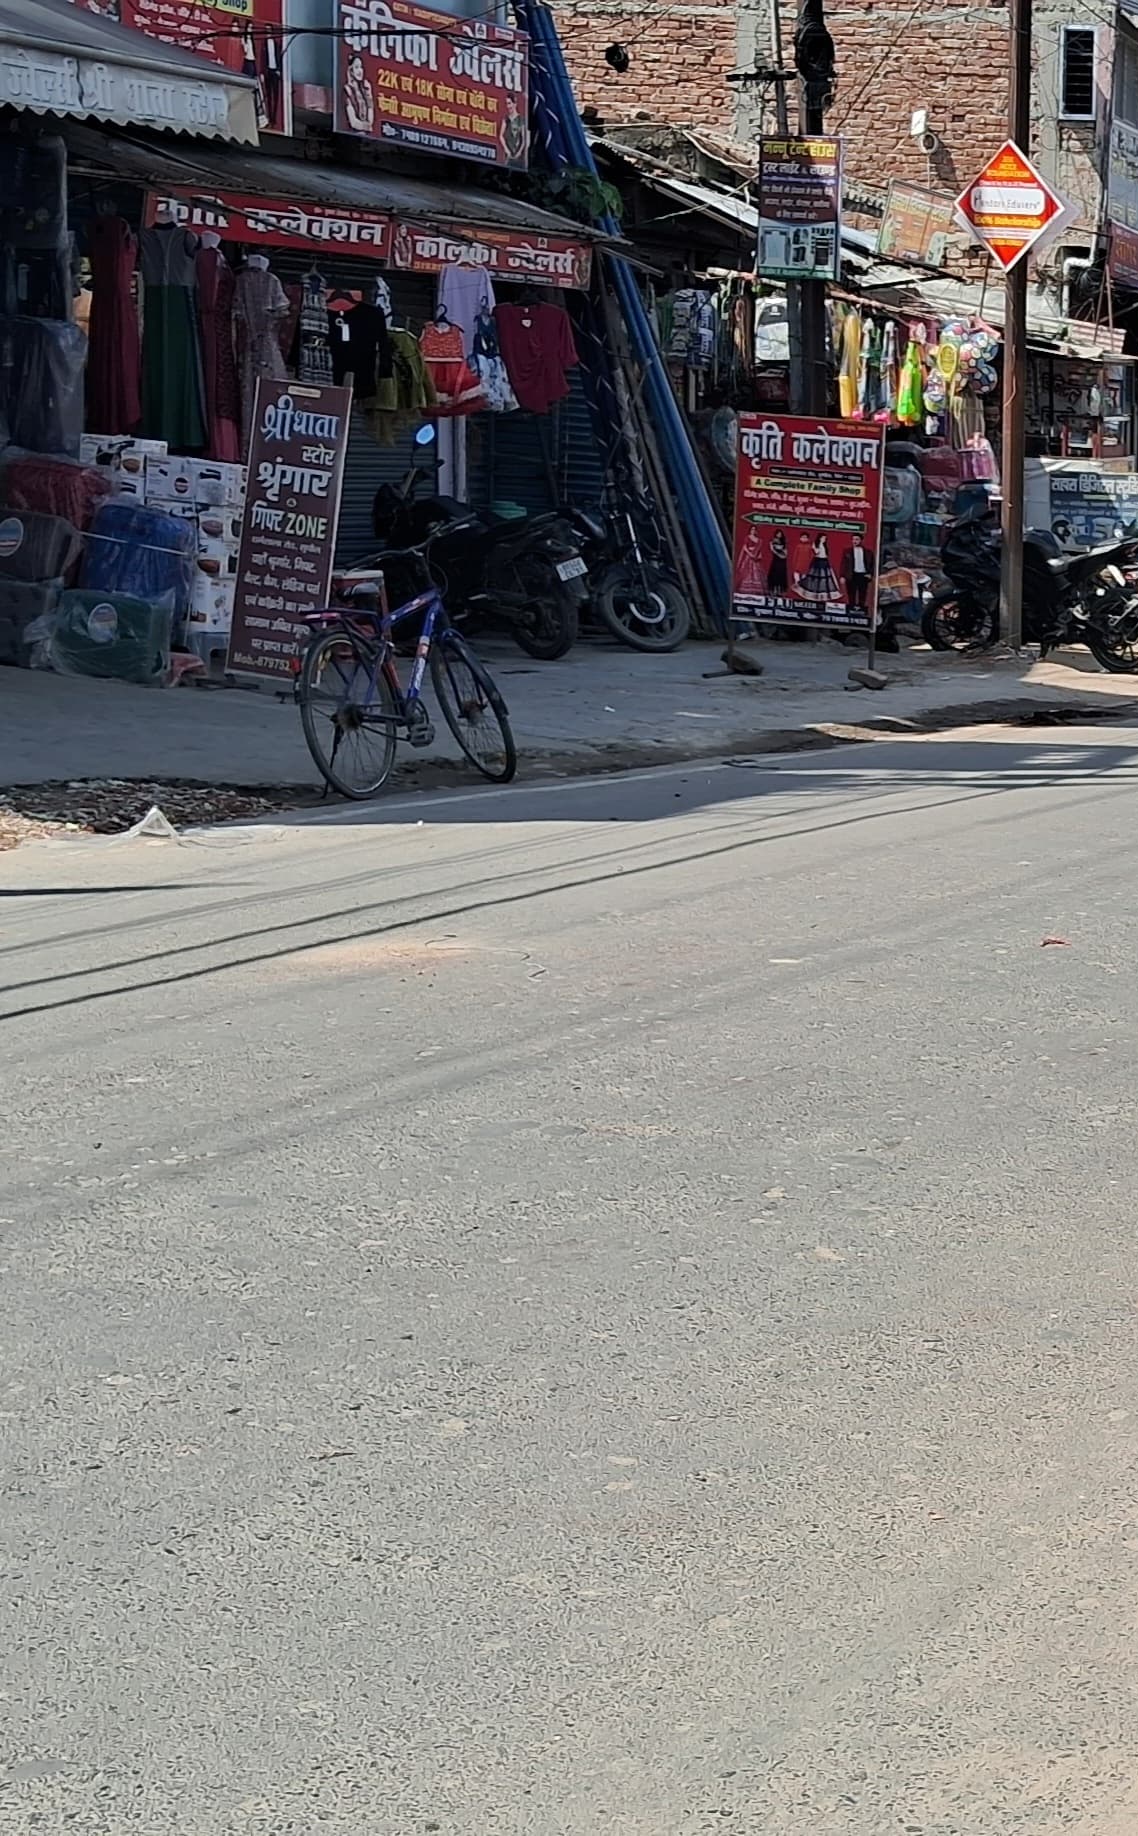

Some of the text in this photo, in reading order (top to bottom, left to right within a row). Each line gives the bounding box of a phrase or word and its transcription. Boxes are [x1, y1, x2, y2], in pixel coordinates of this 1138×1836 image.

[244, 206, 386, 245] कलेक्शन
[740, 421, 880, 469] कृति कलेक्शन
[764, 479, 806, 491] Complete
[807, 481, 838, 494] Family
[838, 485, 861, 495] Shop
[285, 512, 328, 539] ZONE
